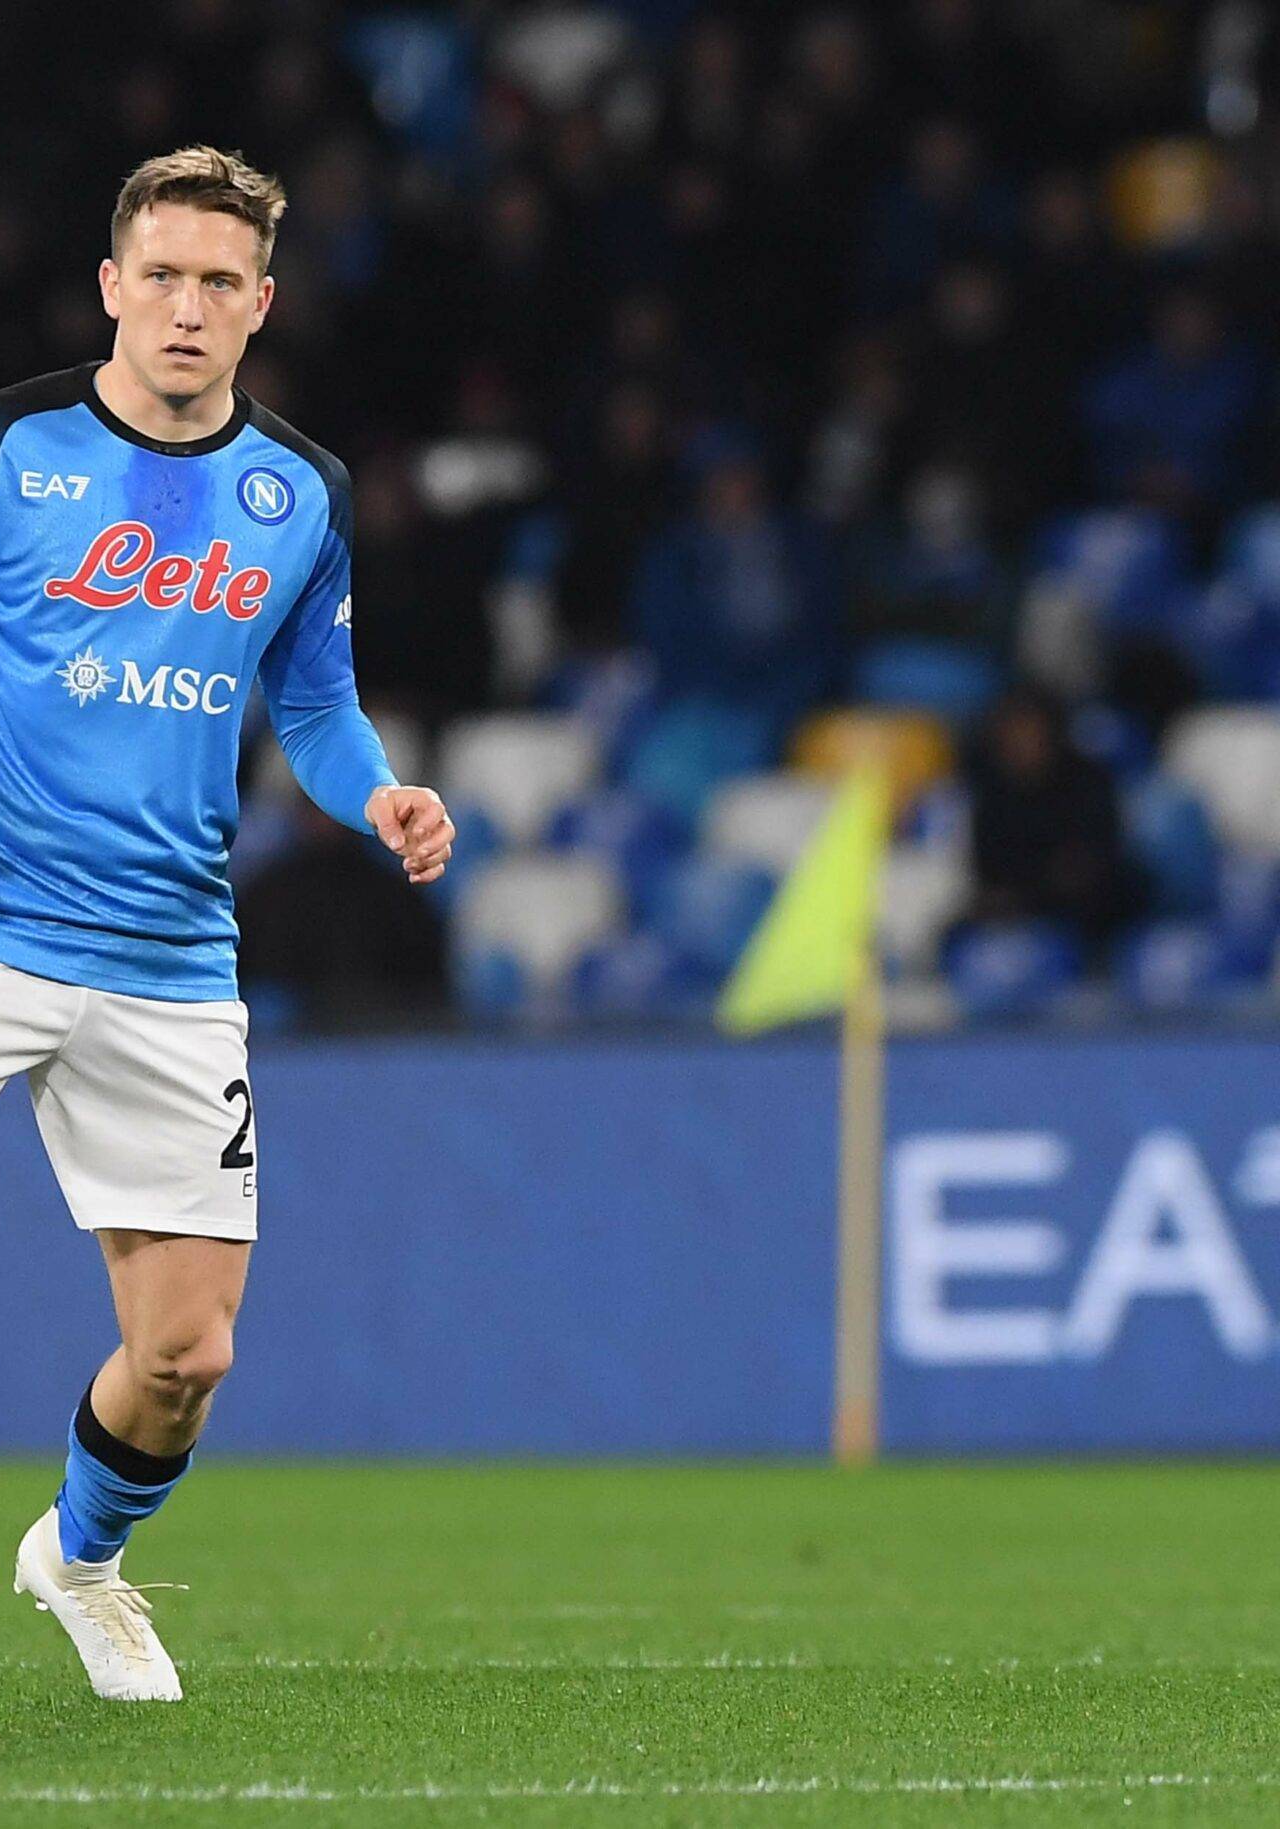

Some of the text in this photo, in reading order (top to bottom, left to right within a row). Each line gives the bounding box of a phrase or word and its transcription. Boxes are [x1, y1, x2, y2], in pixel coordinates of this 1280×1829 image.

[21, 471, 91, 501] EA7
[252, 479, 278, 511] N
[44, 521, 271, 621] Lete
[116, 659, 237, 715] MSC
